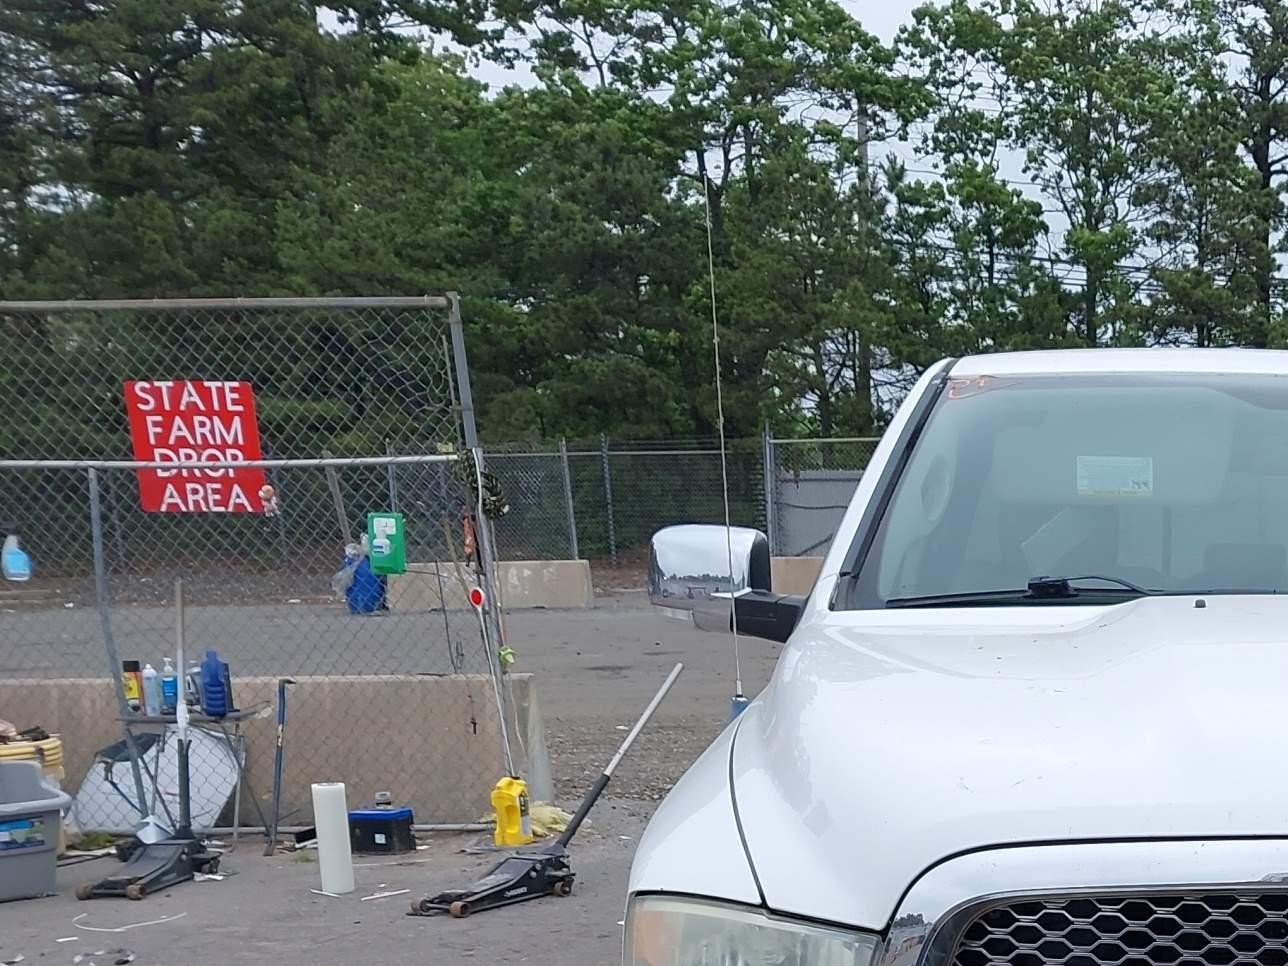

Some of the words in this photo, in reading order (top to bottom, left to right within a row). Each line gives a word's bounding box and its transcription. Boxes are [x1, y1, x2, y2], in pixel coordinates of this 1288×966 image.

[134, 381, 244, 412] STATE
[145, 415, 244, 446] FARM
[153, 448, 244, 478] DROP
[160, 482, 253, 512] AREA
